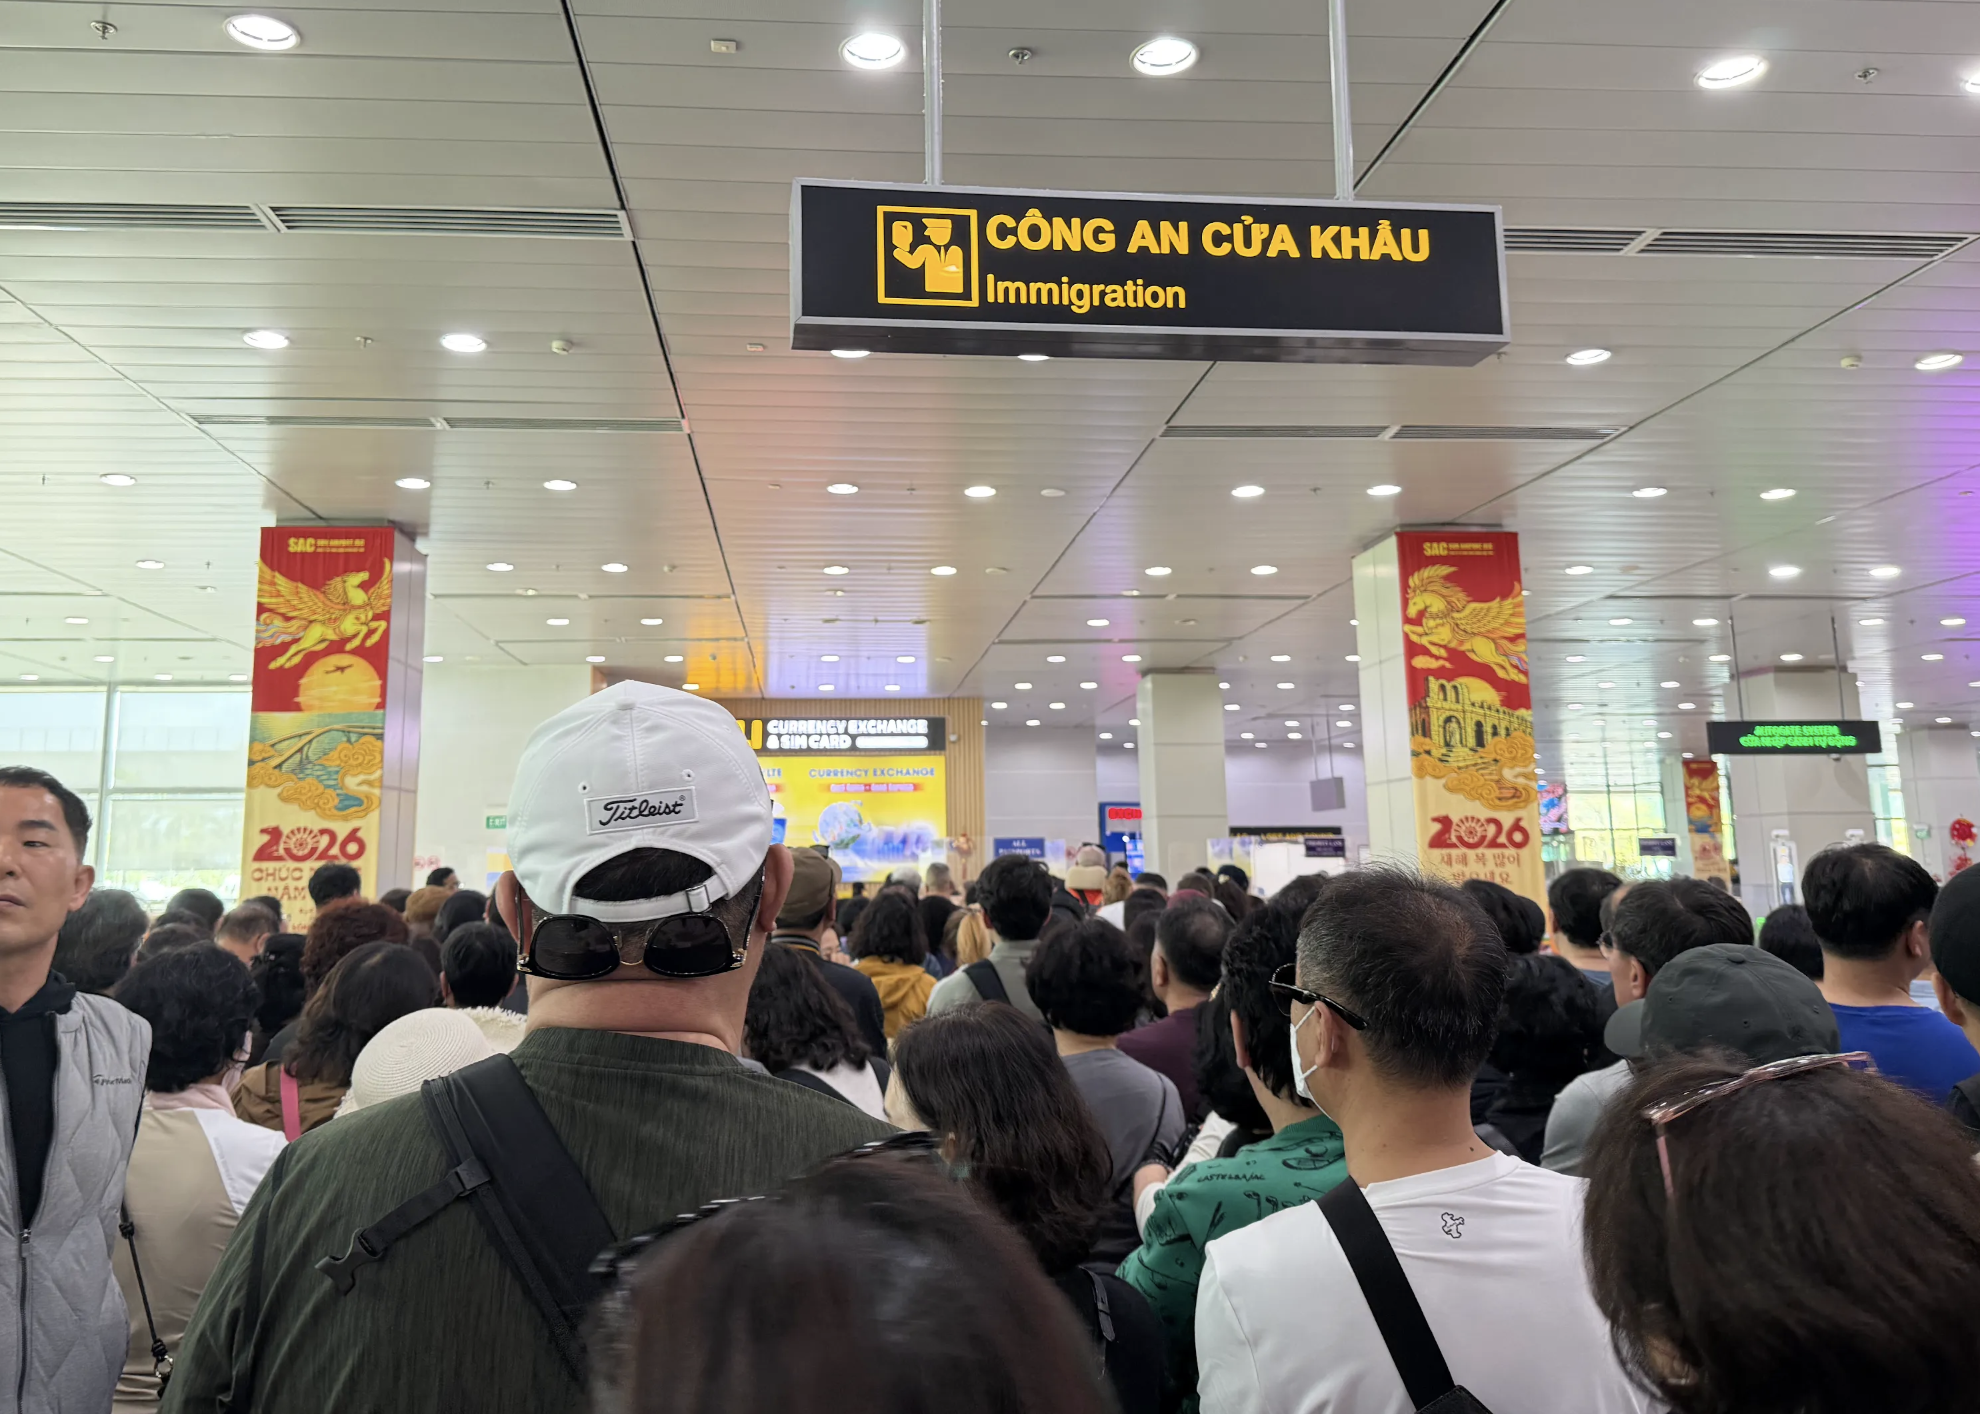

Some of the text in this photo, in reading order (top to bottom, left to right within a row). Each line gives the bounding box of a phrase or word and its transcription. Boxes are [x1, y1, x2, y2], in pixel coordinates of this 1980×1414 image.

[986, 208, 1430, 262] CÔNG AN CỬA KHẨU
[986, 274, 1186, 314] Immigration
[288, 537, 315, 553] SAC
[1423, 542, 1448, 556] SAC
[766, 719, 928, 734] CURRENCY EXCHANGE
[780, 735, 808, 749] SIM
[808, 734, 852, 749] CARD
[809, 767, 935, 778] CURRENCY EXCHANGE
[599, 797, 683, 827] Titleist
[1428, 814, 1530, 849] 2026
[252, 825, 367, 862] 2026
[1441, 852, 1468, 868] 새해
[251, 865, 304, 882] CHÚC
